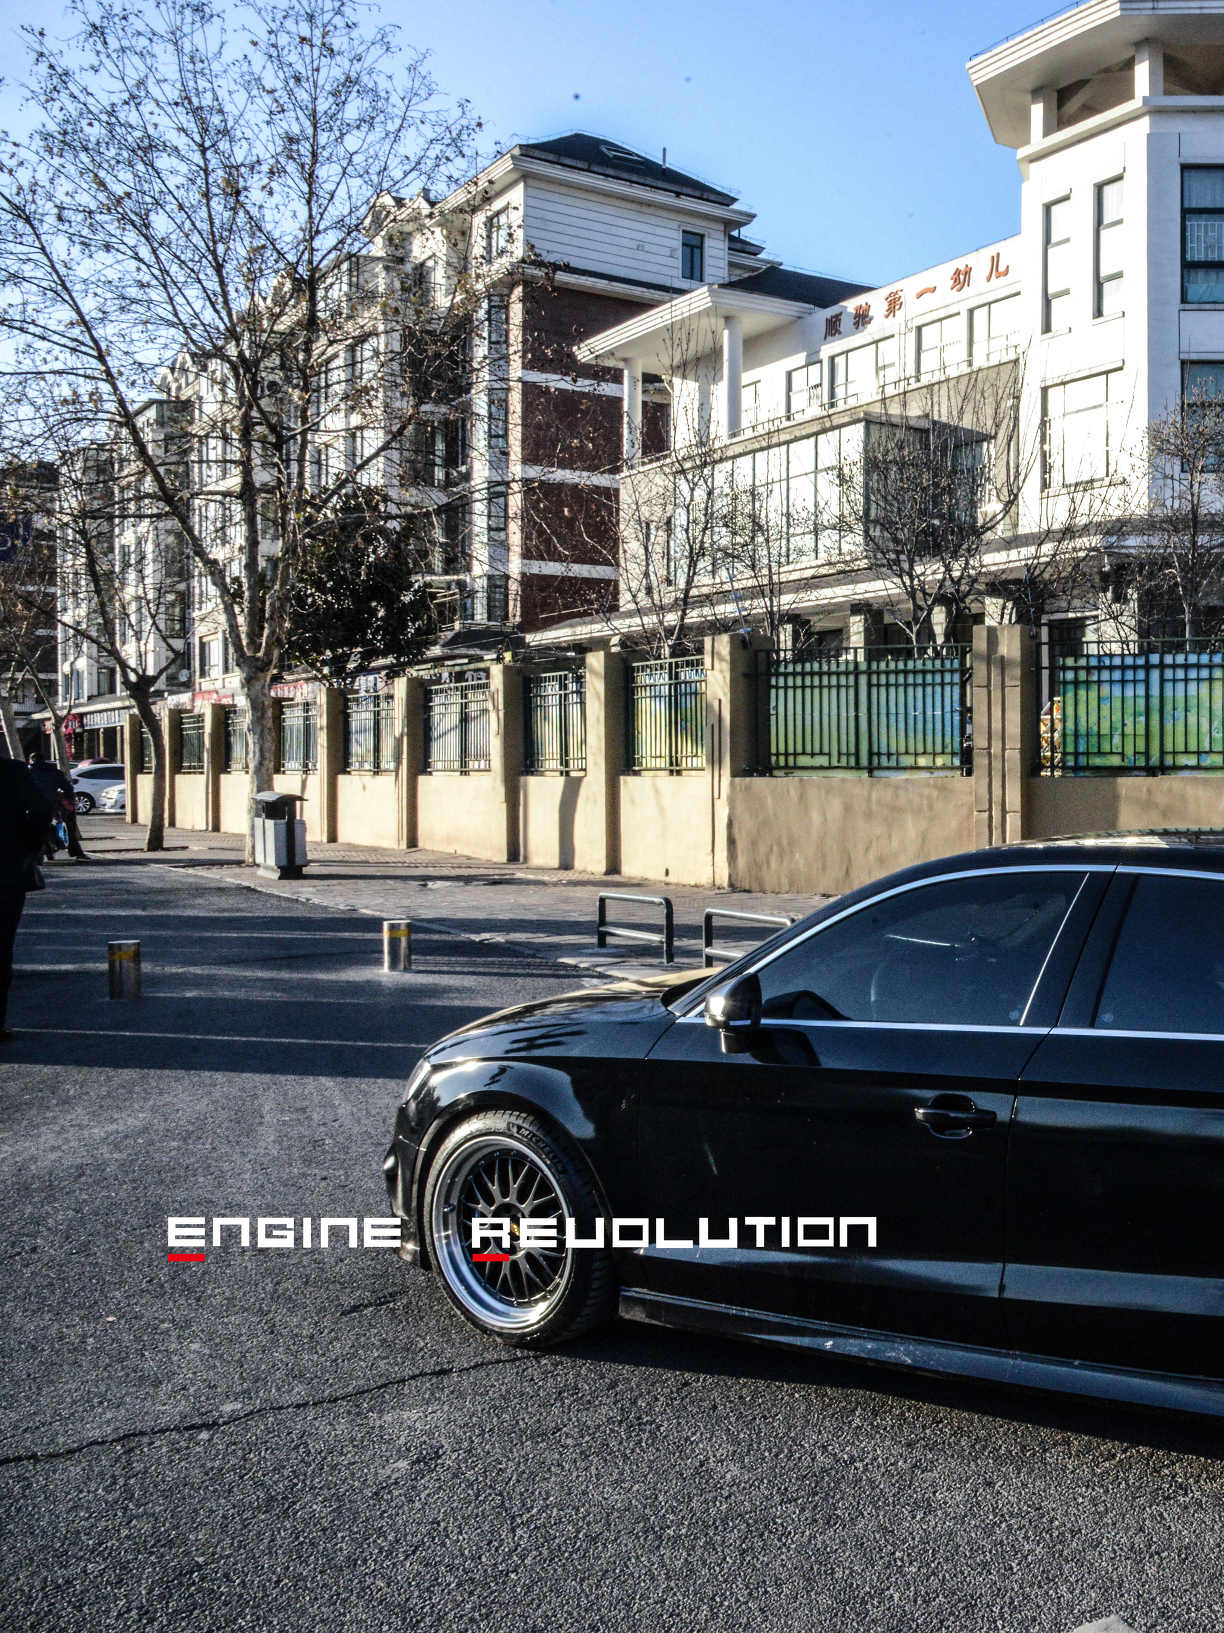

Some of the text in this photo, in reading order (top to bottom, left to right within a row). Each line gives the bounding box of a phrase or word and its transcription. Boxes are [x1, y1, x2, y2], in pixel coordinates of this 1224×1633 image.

[823, 251, 1010, 341] 顺驰第一幼儿
